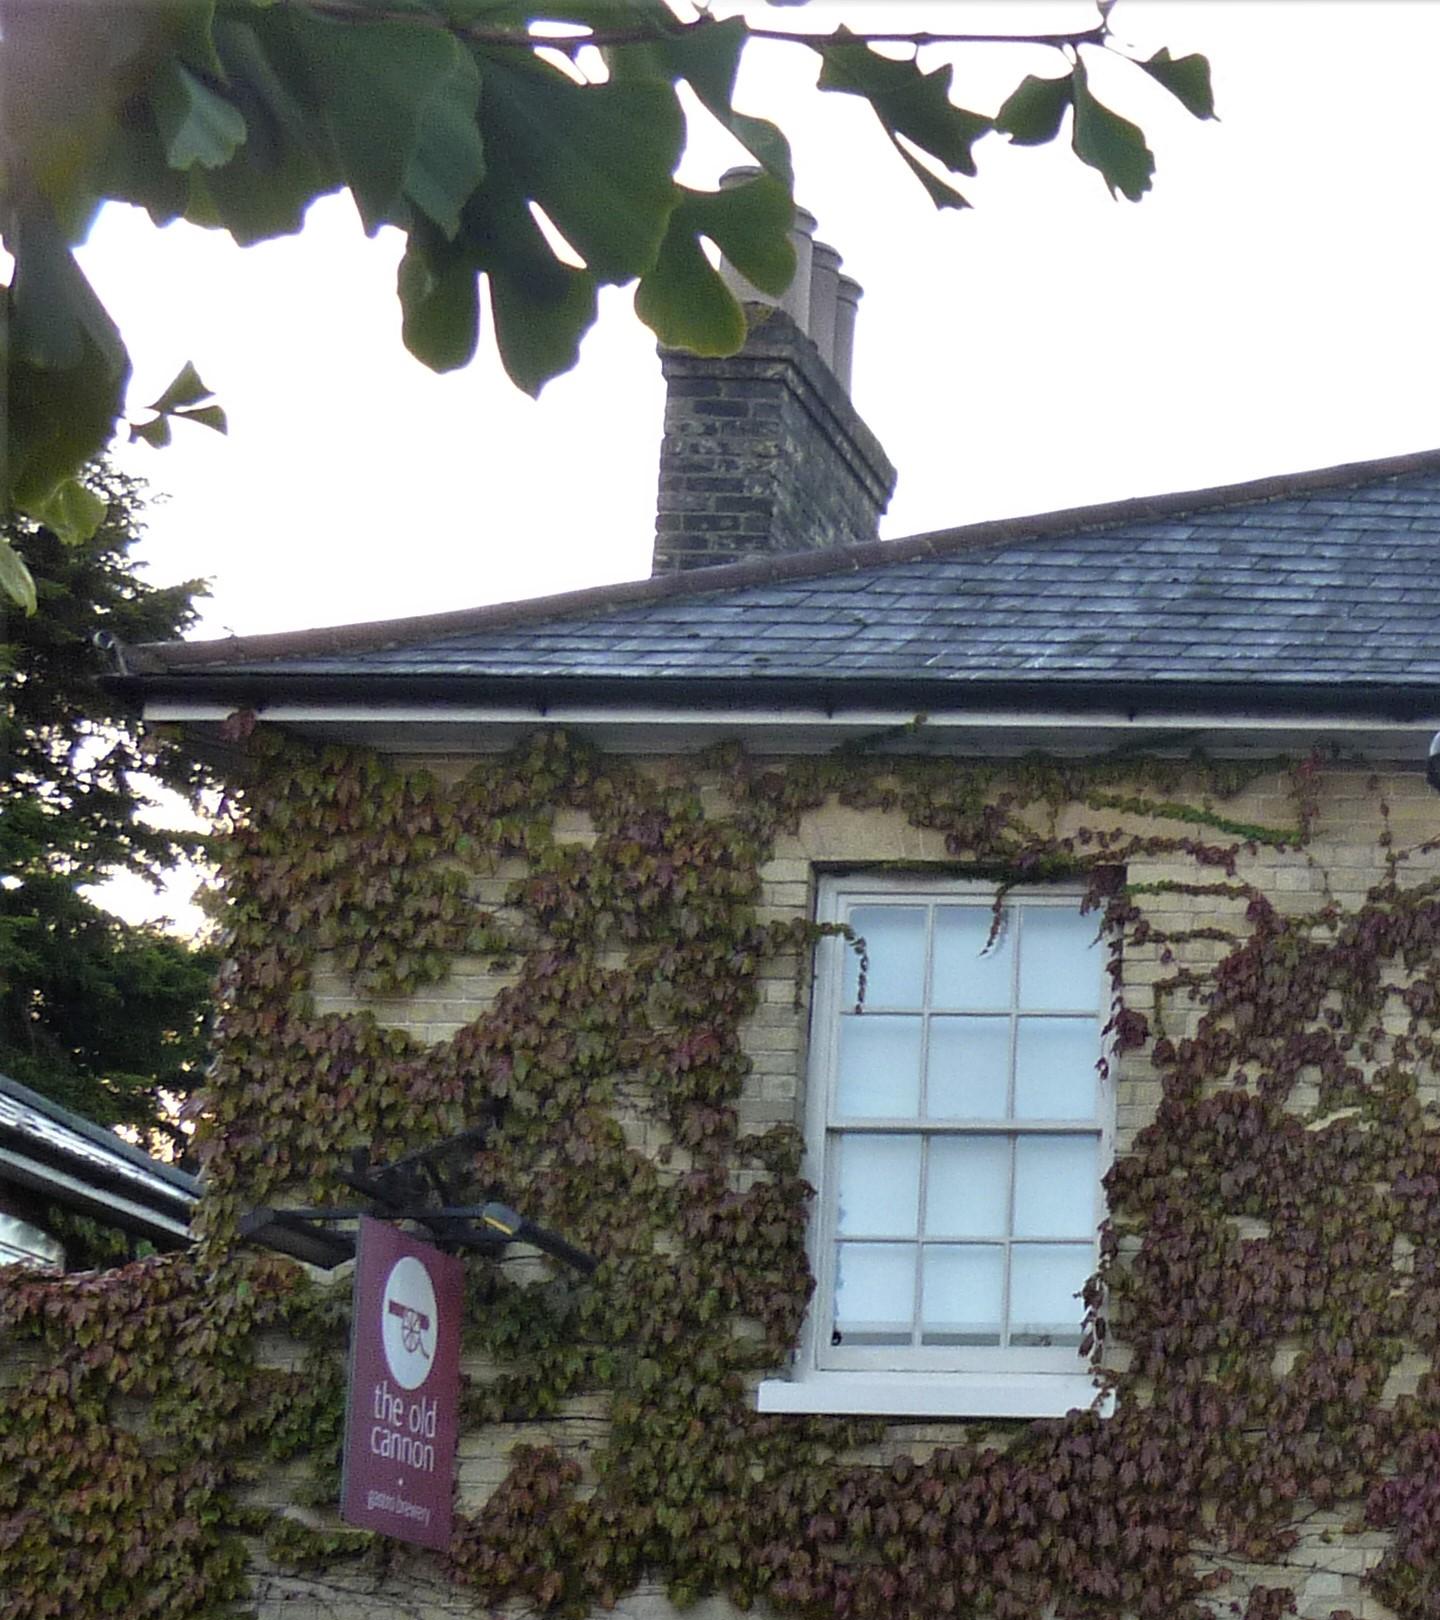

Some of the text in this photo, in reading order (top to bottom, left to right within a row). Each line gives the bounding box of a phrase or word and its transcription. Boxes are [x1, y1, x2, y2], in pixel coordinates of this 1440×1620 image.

[374, 1380, 438, 1438] the old
[371, 1423, 436, 1473] cannon
